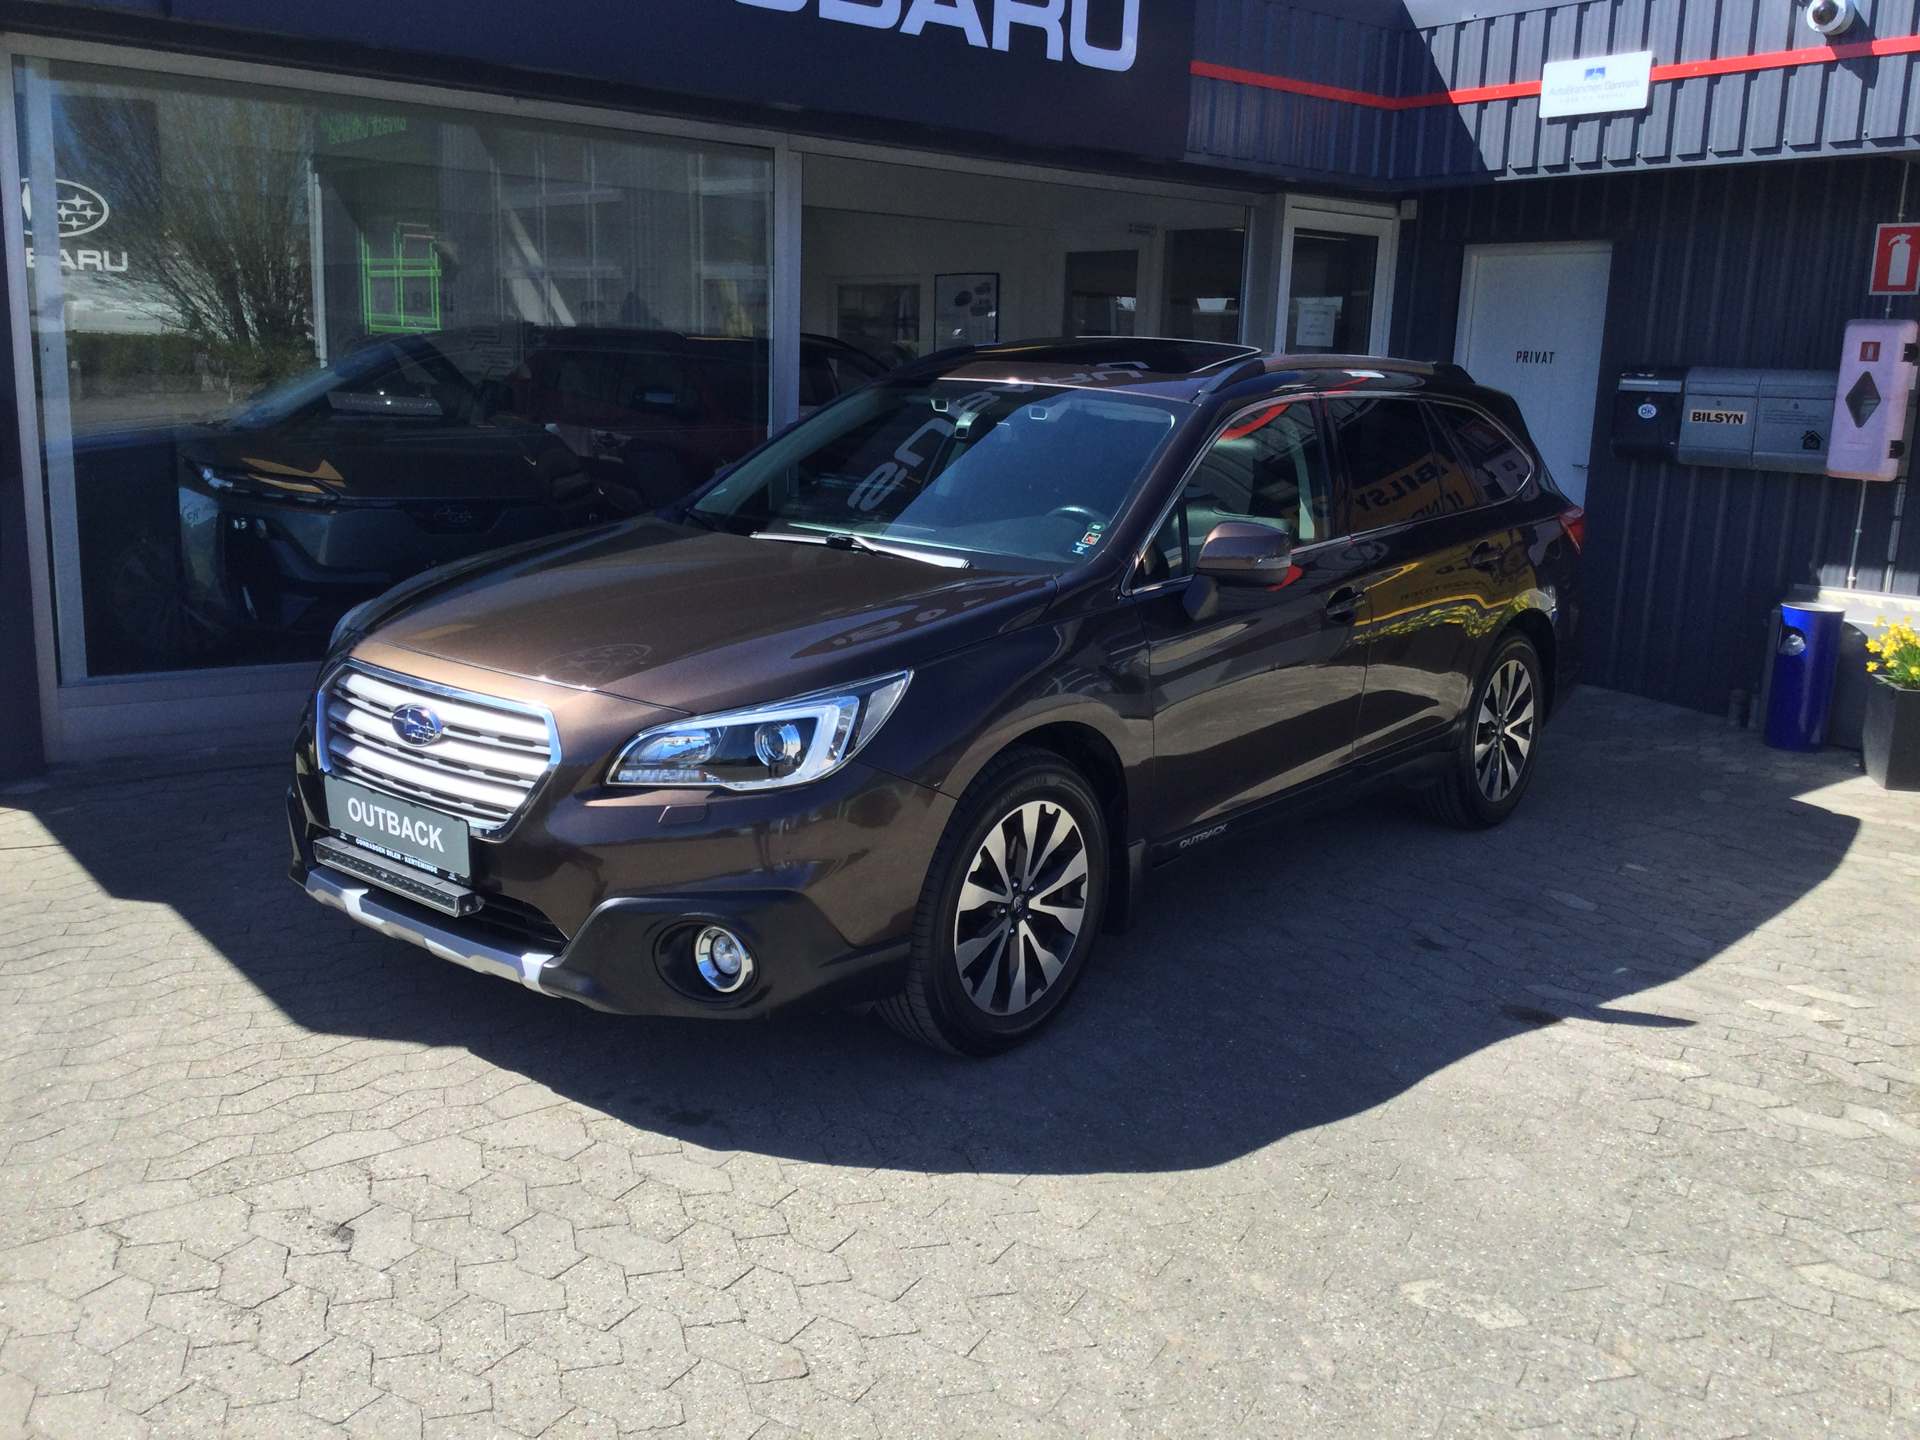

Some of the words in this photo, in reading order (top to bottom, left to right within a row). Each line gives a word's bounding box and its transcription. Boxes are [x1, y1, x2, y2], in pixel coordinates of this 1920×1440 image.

[735, 0, 1140, 72] ARU
[1604, 78, 1641, 91] Danmark
[1516, 350, 1555, 364] PRIVAT
[1640, 407, 1653, 416] DK
[1691, 411, 1745, 424] BILSYN
[1805, 439, 1818, 449] 56
[347, 797, 445, 853] OUTBACK
[1179, 823, 1229, 849] OUTBACK
[385, 849, 402, 861] BILER
[404, 856, 438, 874] KERTEMINDE
